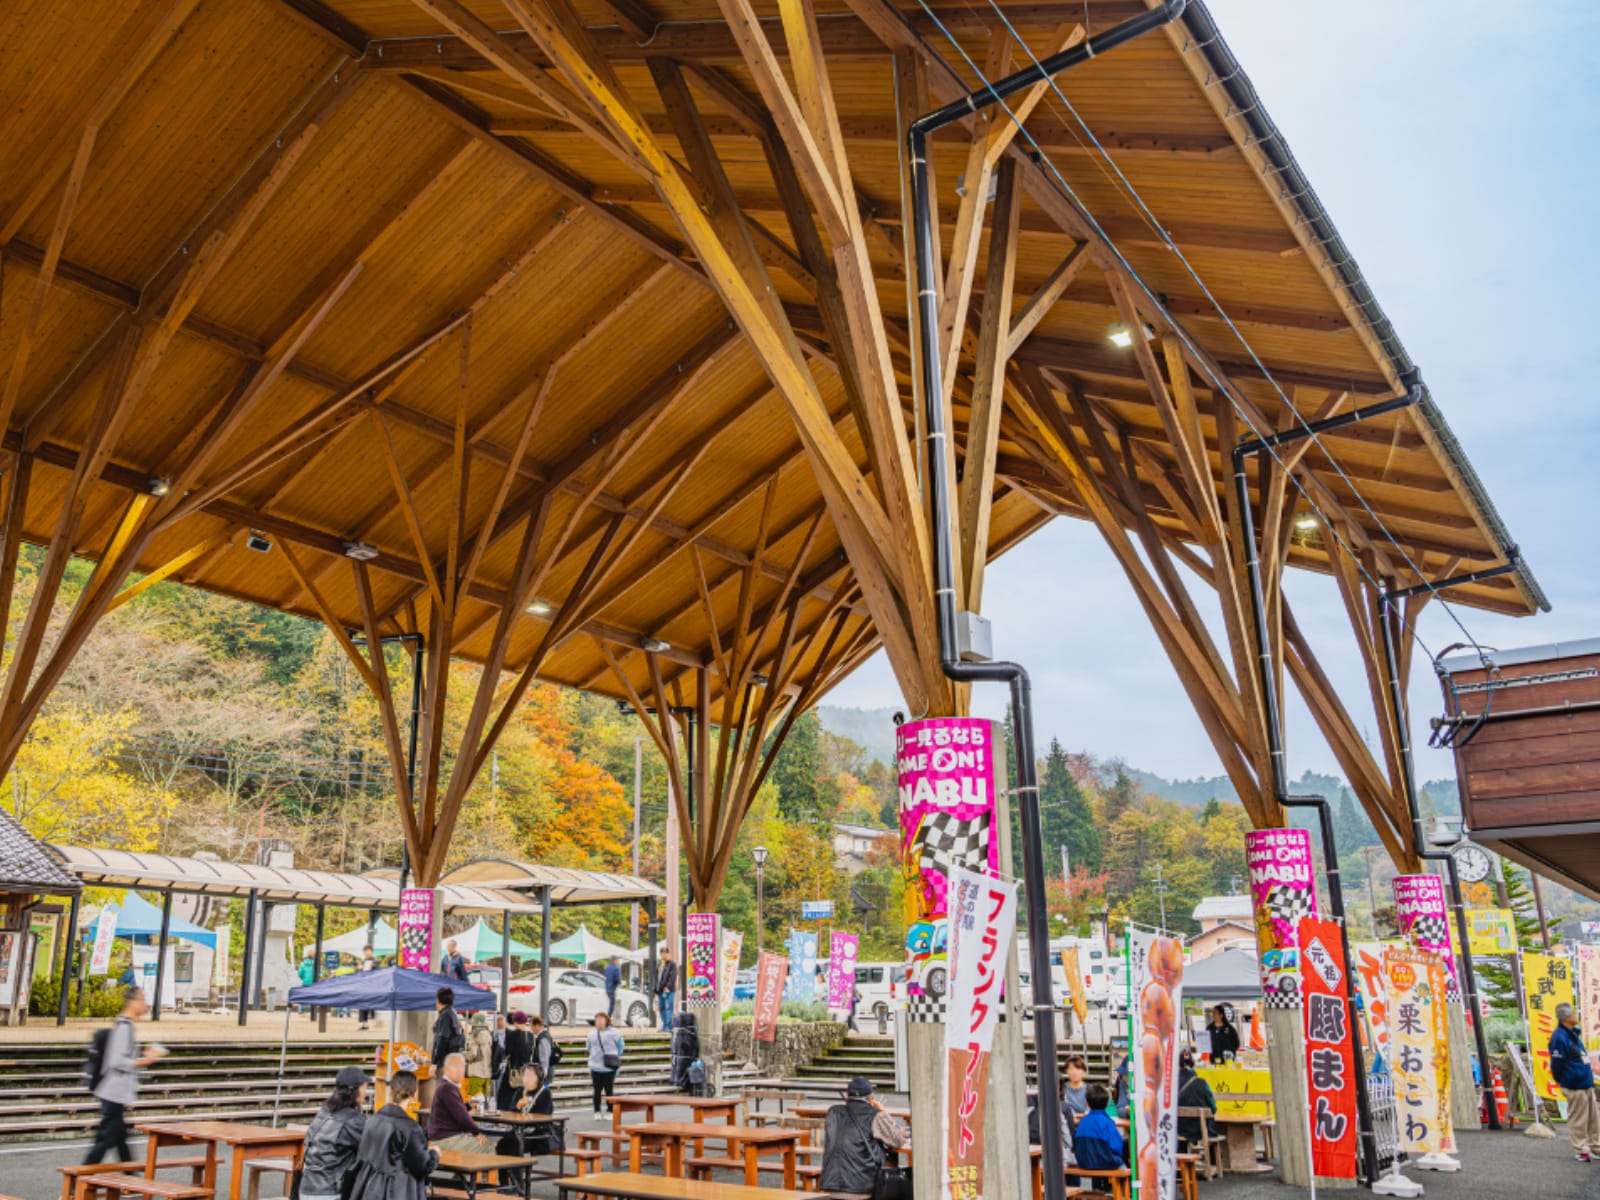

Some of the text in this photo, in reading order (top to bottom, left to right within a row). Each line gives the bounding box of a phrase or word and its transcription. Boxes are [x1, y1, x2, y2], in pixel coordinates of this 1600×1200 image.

[932, 748, 984, 772] ON!
[959, 889, 1006, 1159] フランクフルト
[1529, 959, 1567, 1011] 稲武産
[1309, 993, 1346, 1140] 豚まん
[1397, 1003, 1428, 1142] 栗おこわ
